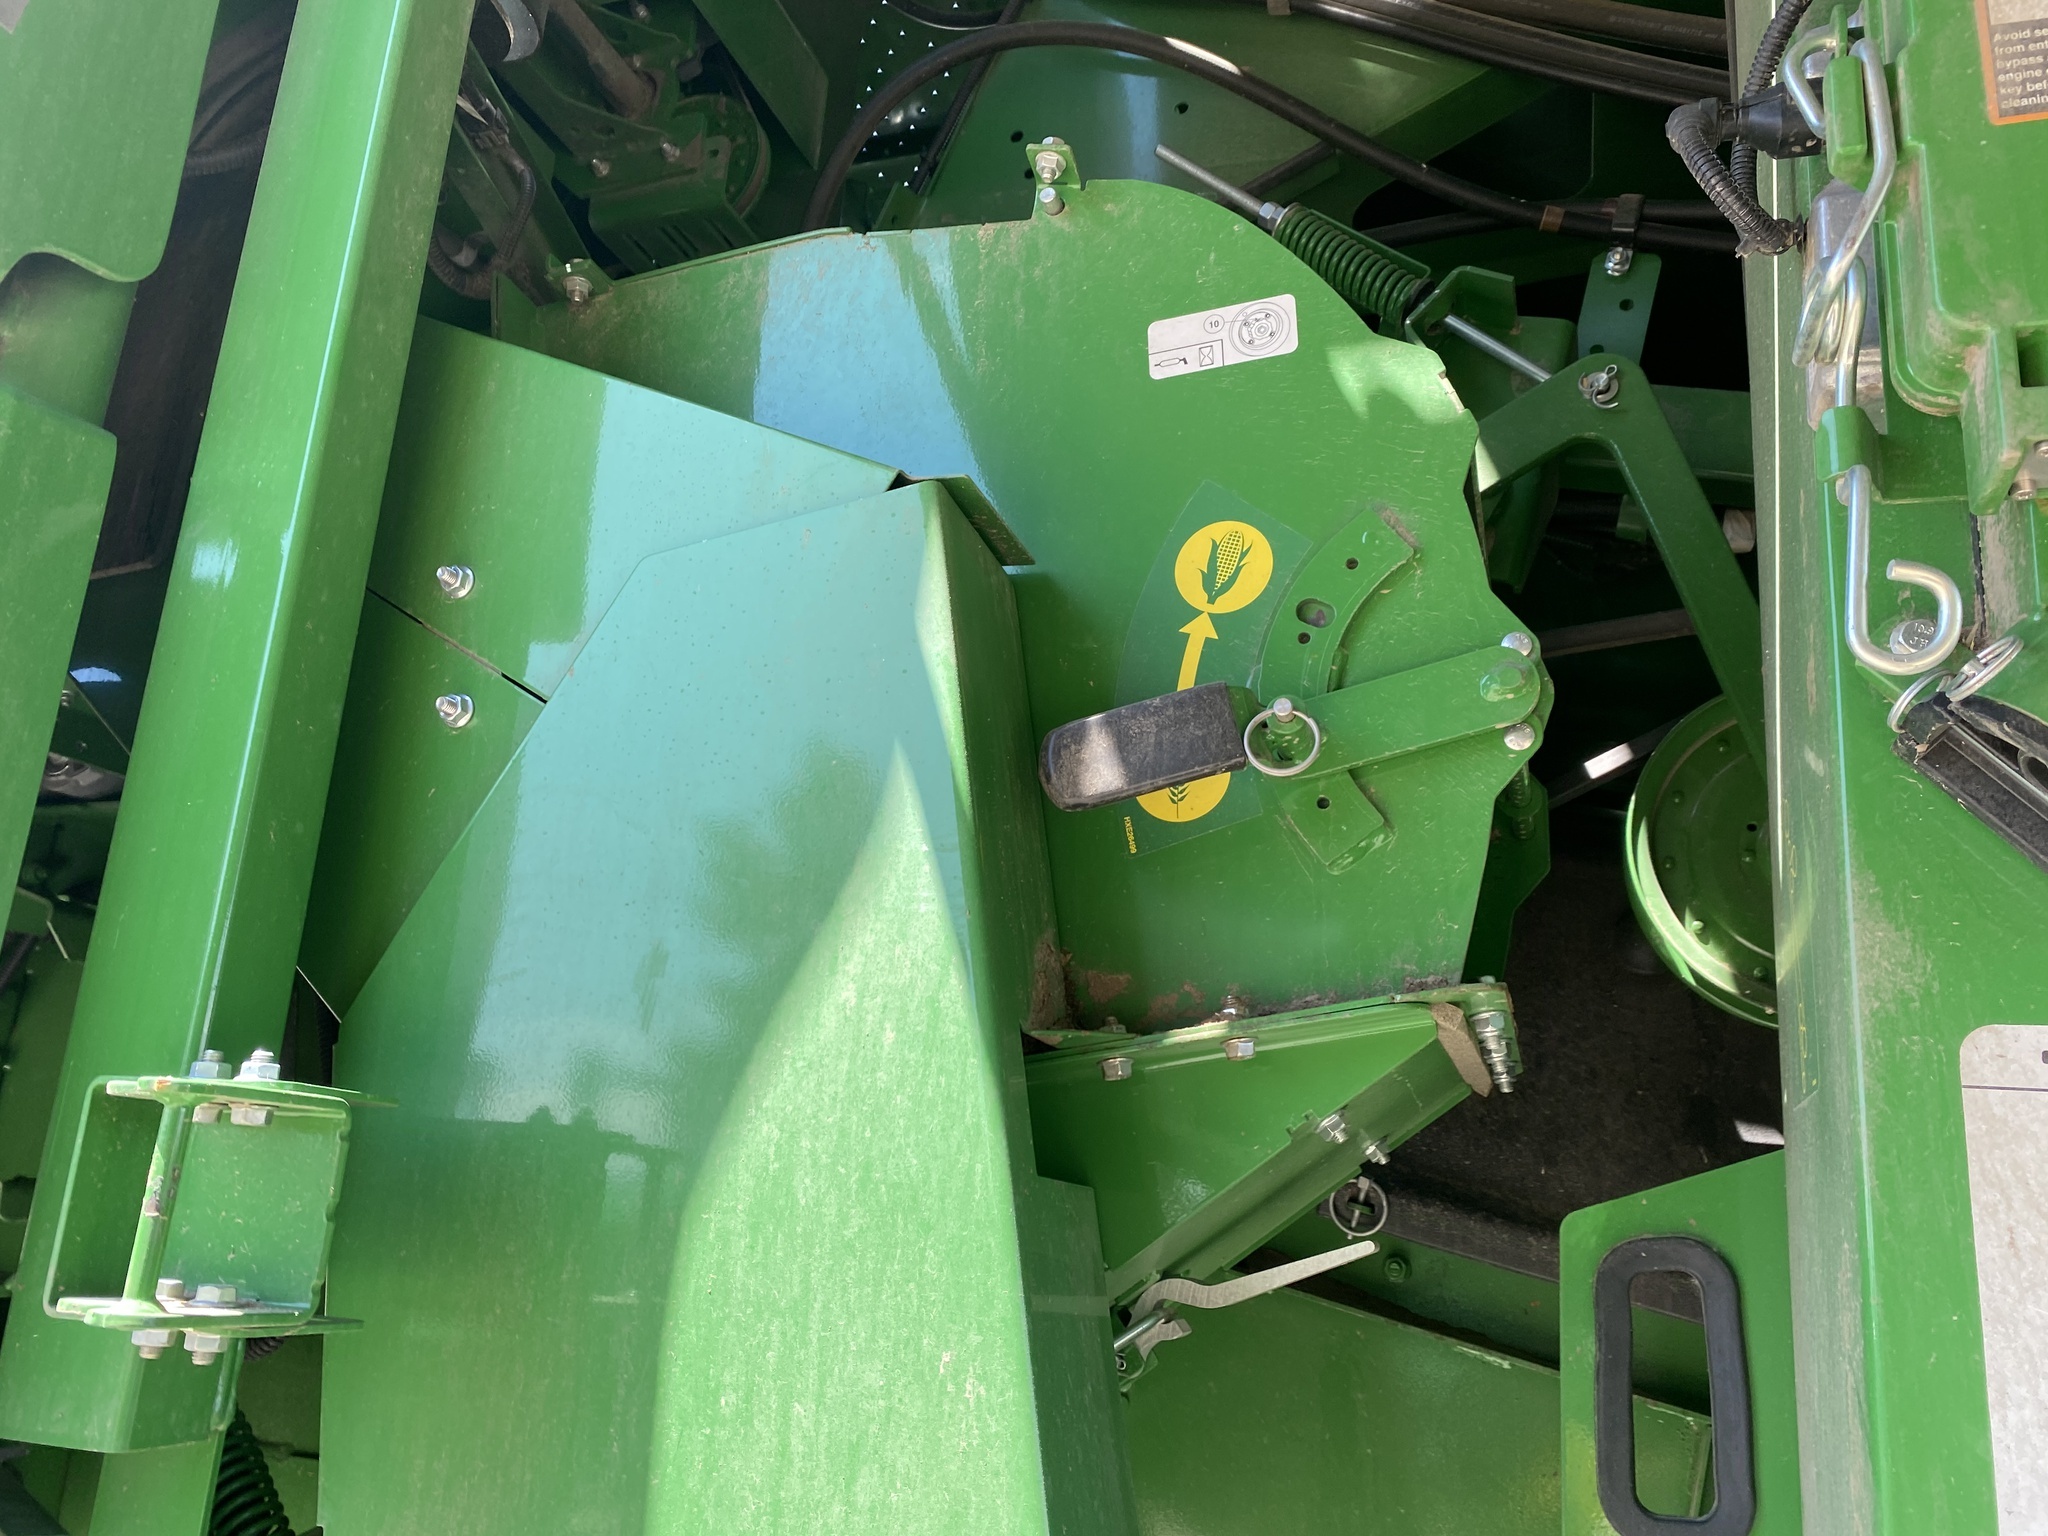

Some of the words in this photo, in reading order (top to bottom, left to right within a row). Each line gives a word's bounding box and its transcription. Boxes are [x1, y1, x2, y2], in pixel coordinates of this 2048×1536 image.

[1993, 29, 2030, 42] Avoid
[2033, 28, 2048, 37] se
[1995, 44, 2025, 56] from
[2028, 40, 2048, 51] ent
[1996, 56, 2044, 69] bypass
[1998, 69, 2042, 82] engine
[2000, 85, 2022, 96] key
[2026, 80, 2048, 91] bef
[2001, 94, 2048, 108] cleanin
[1209, 320, 1220, 329] 10
